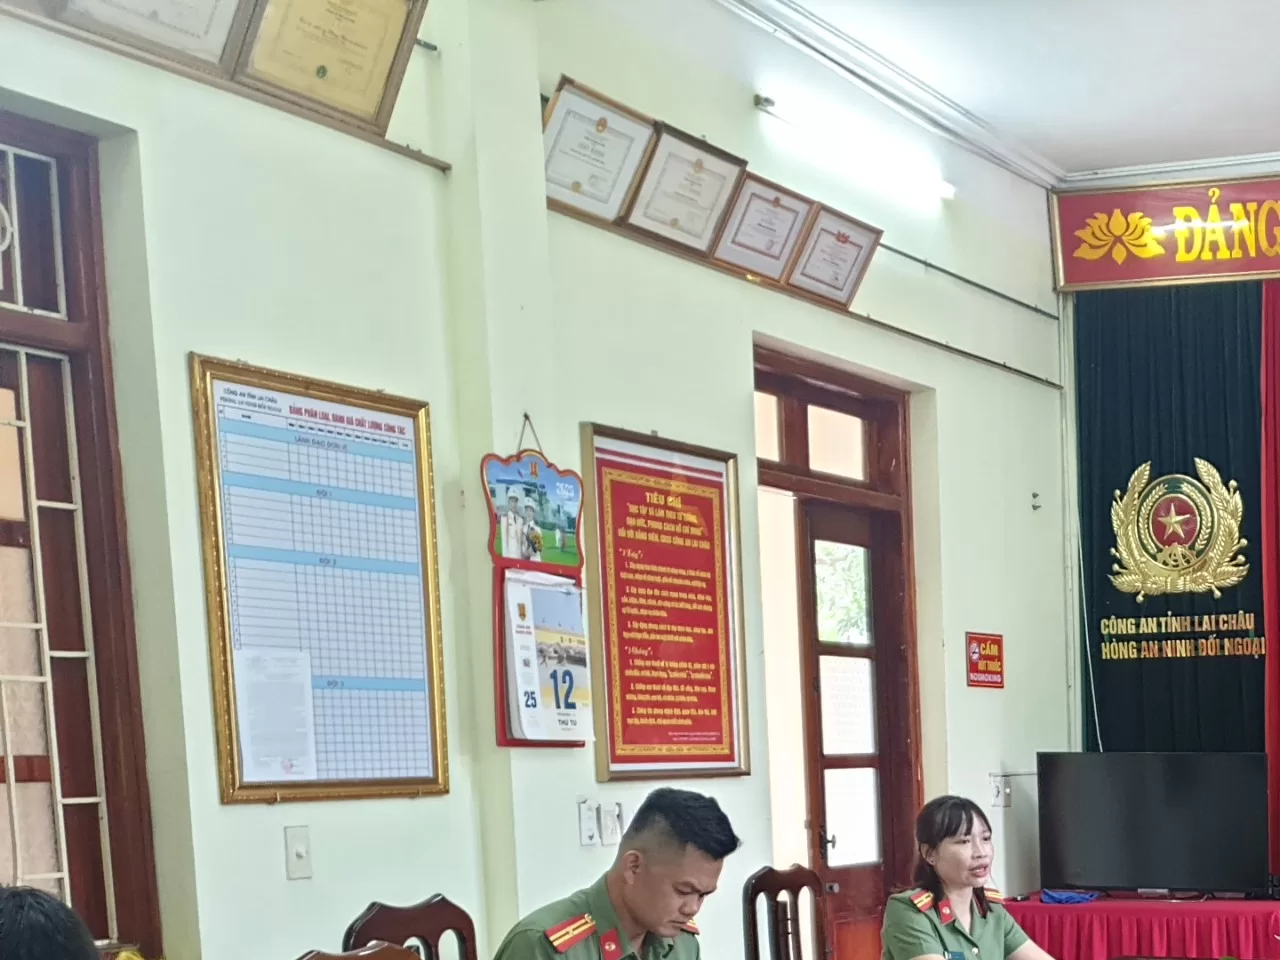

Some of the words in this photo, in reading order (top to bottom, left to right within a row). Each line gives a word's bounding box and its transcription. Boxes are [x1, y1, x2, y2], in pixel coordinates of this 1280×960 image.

[1100, 615, 1135, 634] CÔNG
[1139, 617, 1157, 634] AN
[1160, 610, 1190, 632] TỈNH
[1194, 614, 1216, 631] LAI
[1219, 610, 1255, 630] CHÂU
[980, 640, 999, 656] CẤM
[1141, 641, 1159, 658] AN
[1162, 640, 1195, 657] NINH
[1198, 634, 1221, 656] ĐỐI
[1224, 637, 1266, 659] NGOẠI
[524, 691, 537, 708] 25
[550, 669, 576, 709] 12
